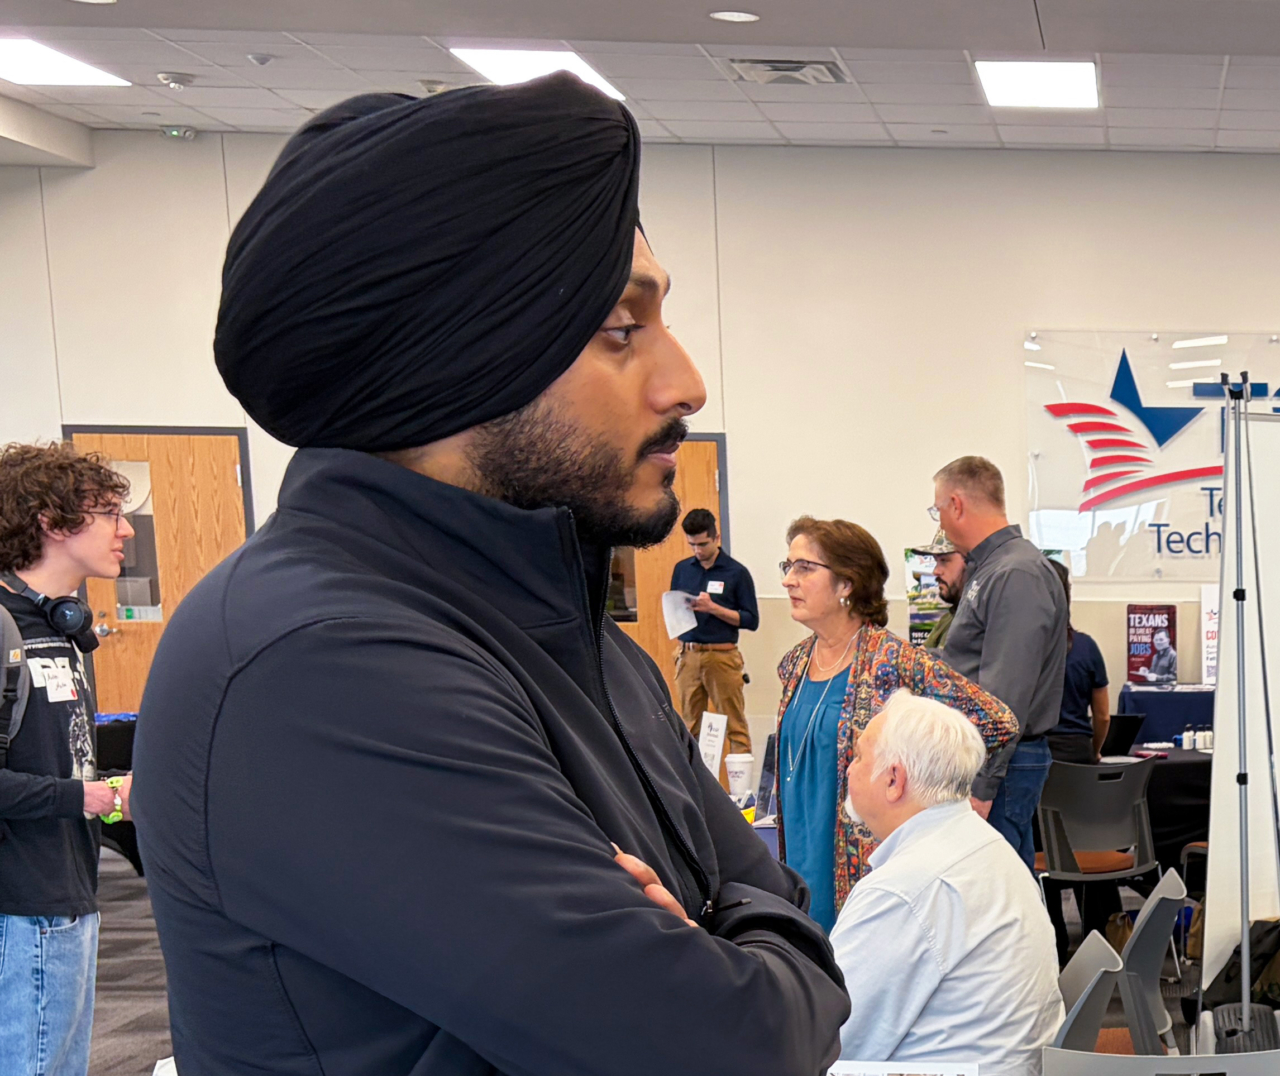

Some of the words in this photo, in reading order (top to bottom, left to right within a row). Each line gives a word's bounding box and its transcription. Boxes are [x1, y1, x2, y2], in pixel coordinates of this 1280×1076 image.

[1148, 522, 1222, 554] Tech
[1129, 613, 1169, 628] TEXANS
[1130, 643, 1152, 655] JOBS
